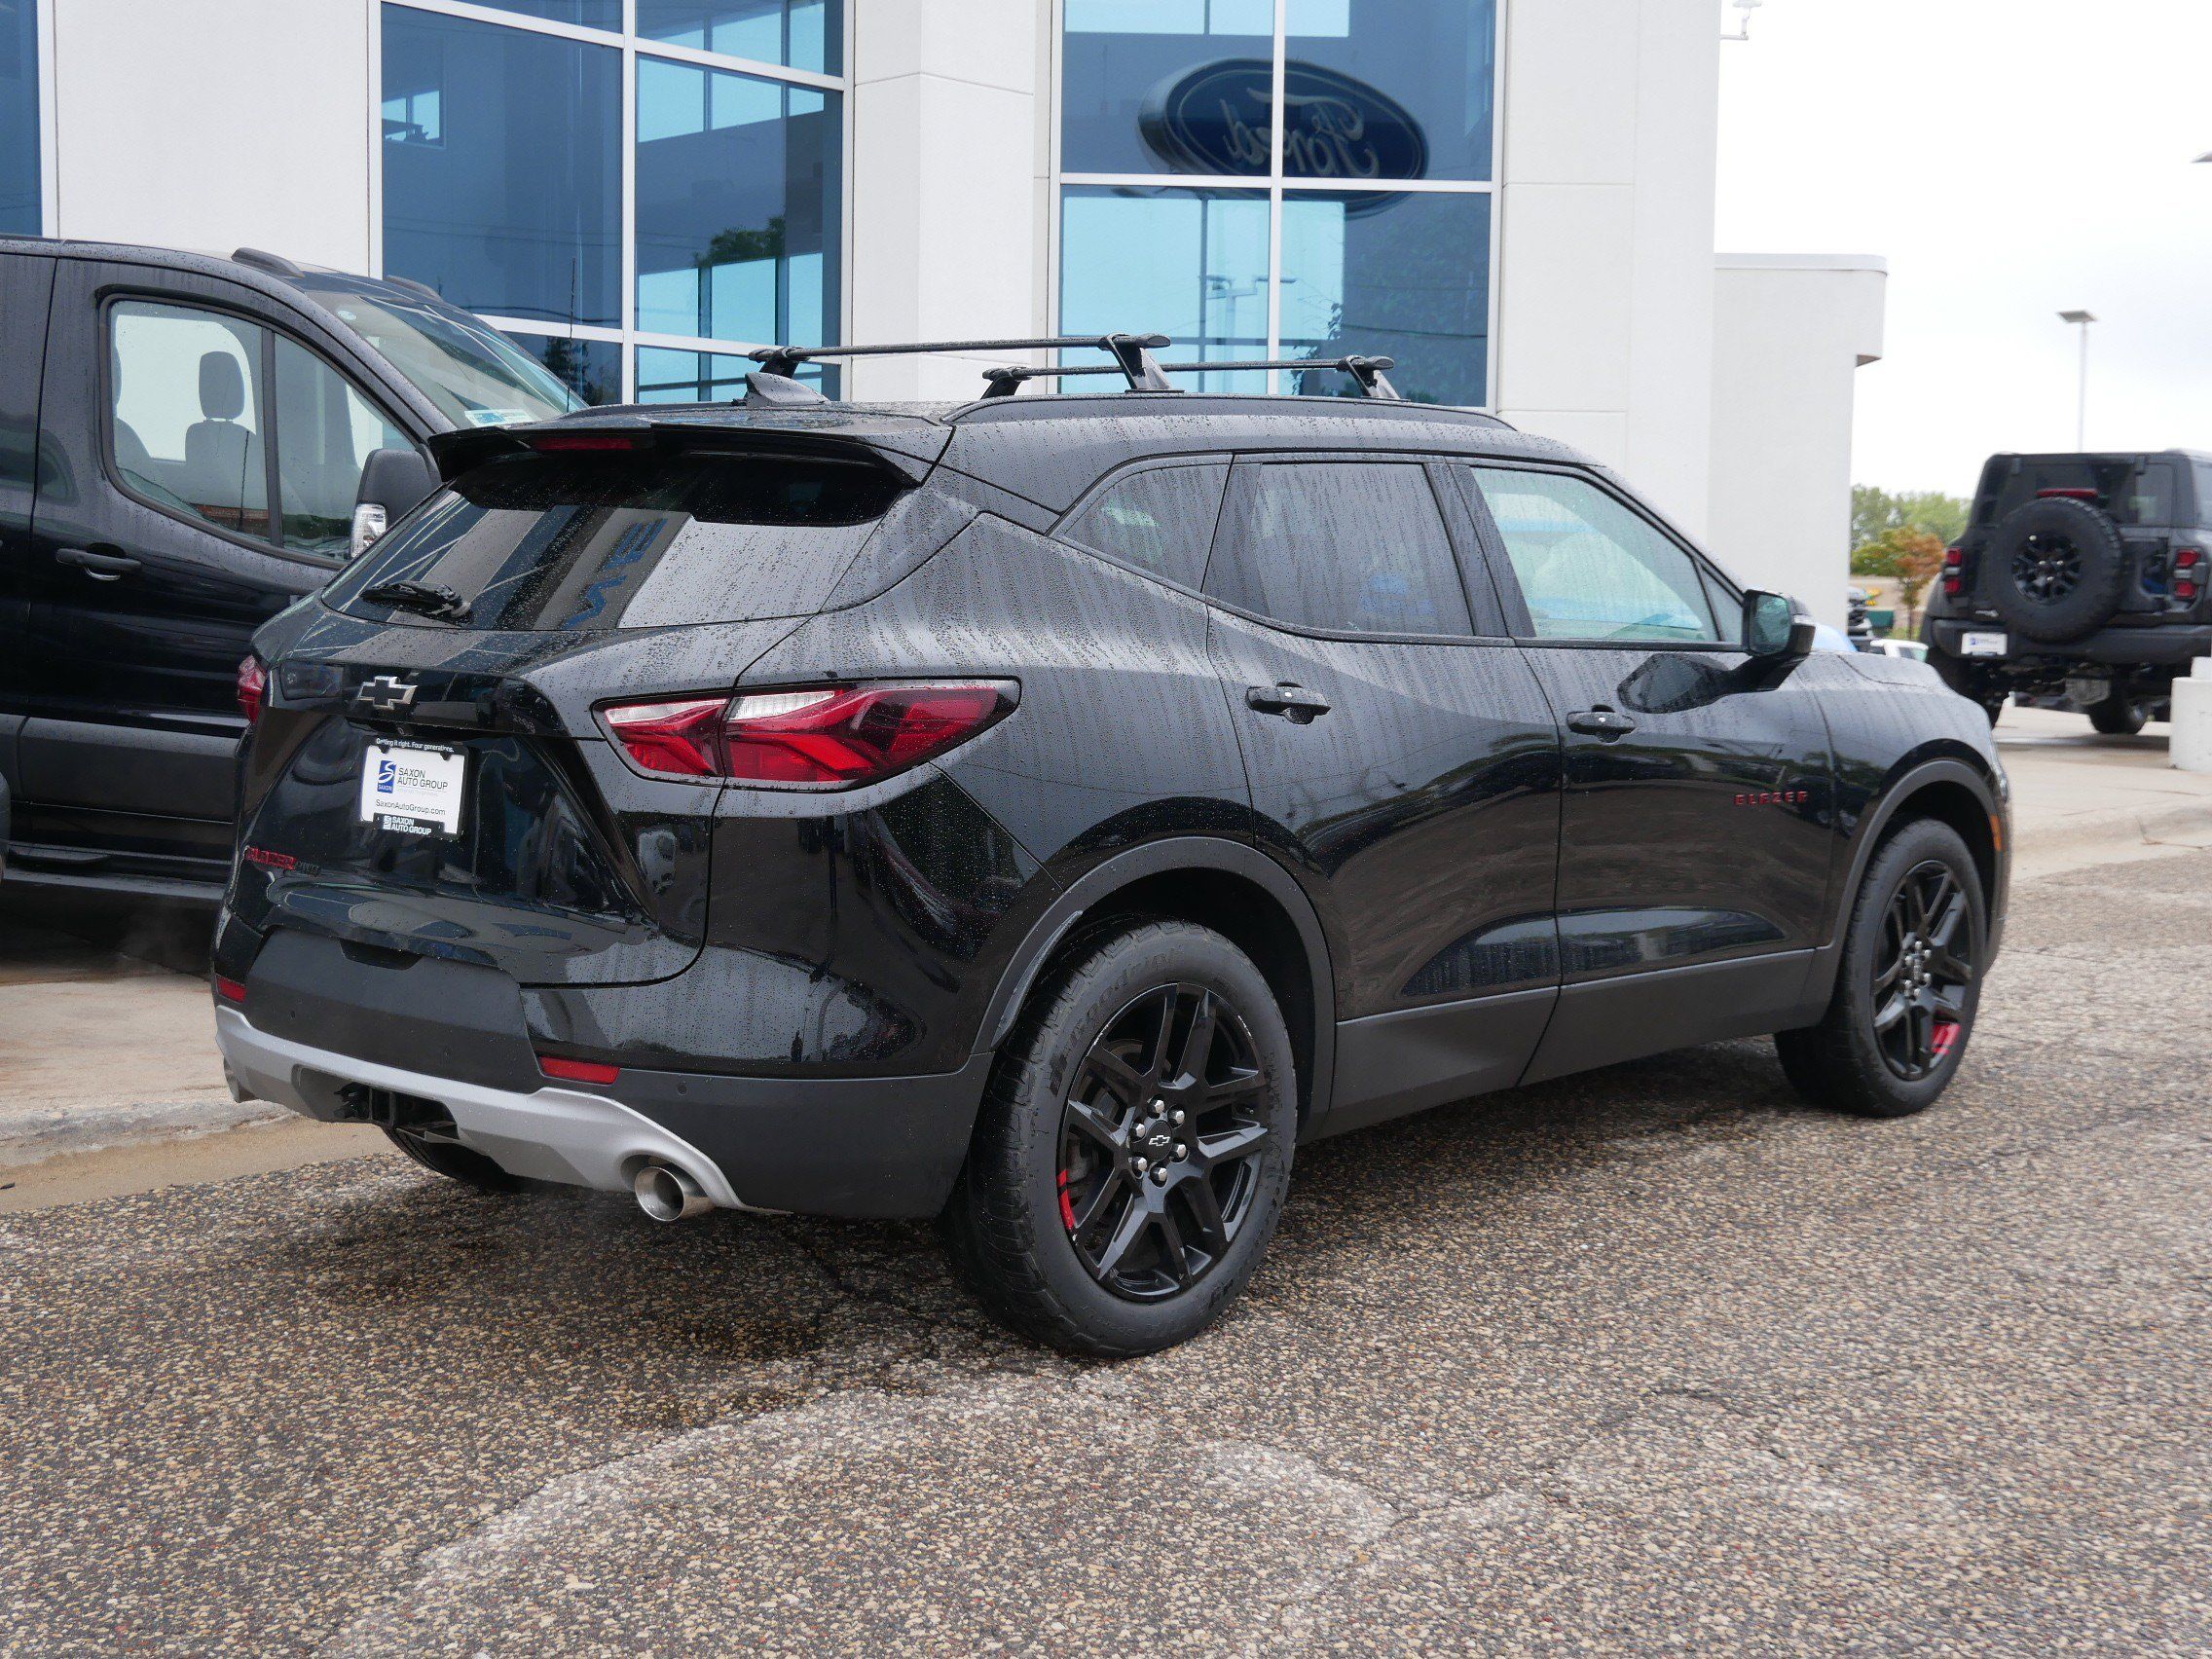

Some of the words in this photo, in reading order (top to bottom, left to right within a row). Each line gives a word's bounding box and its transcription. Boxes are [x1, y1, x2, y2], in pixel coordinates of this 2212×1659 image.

[398, 767, 425, 778] SAXON
[397, 777, 419, 787] AUTO
[419, 780, 449, 791] GROUP
[376, 798, 446, 815] SaxonAutoGroup.com
[391, 816, 415, 826] SAXON
[390, 824, 409, 832] AUTO
[409, 826, 432, 835] GROUP
